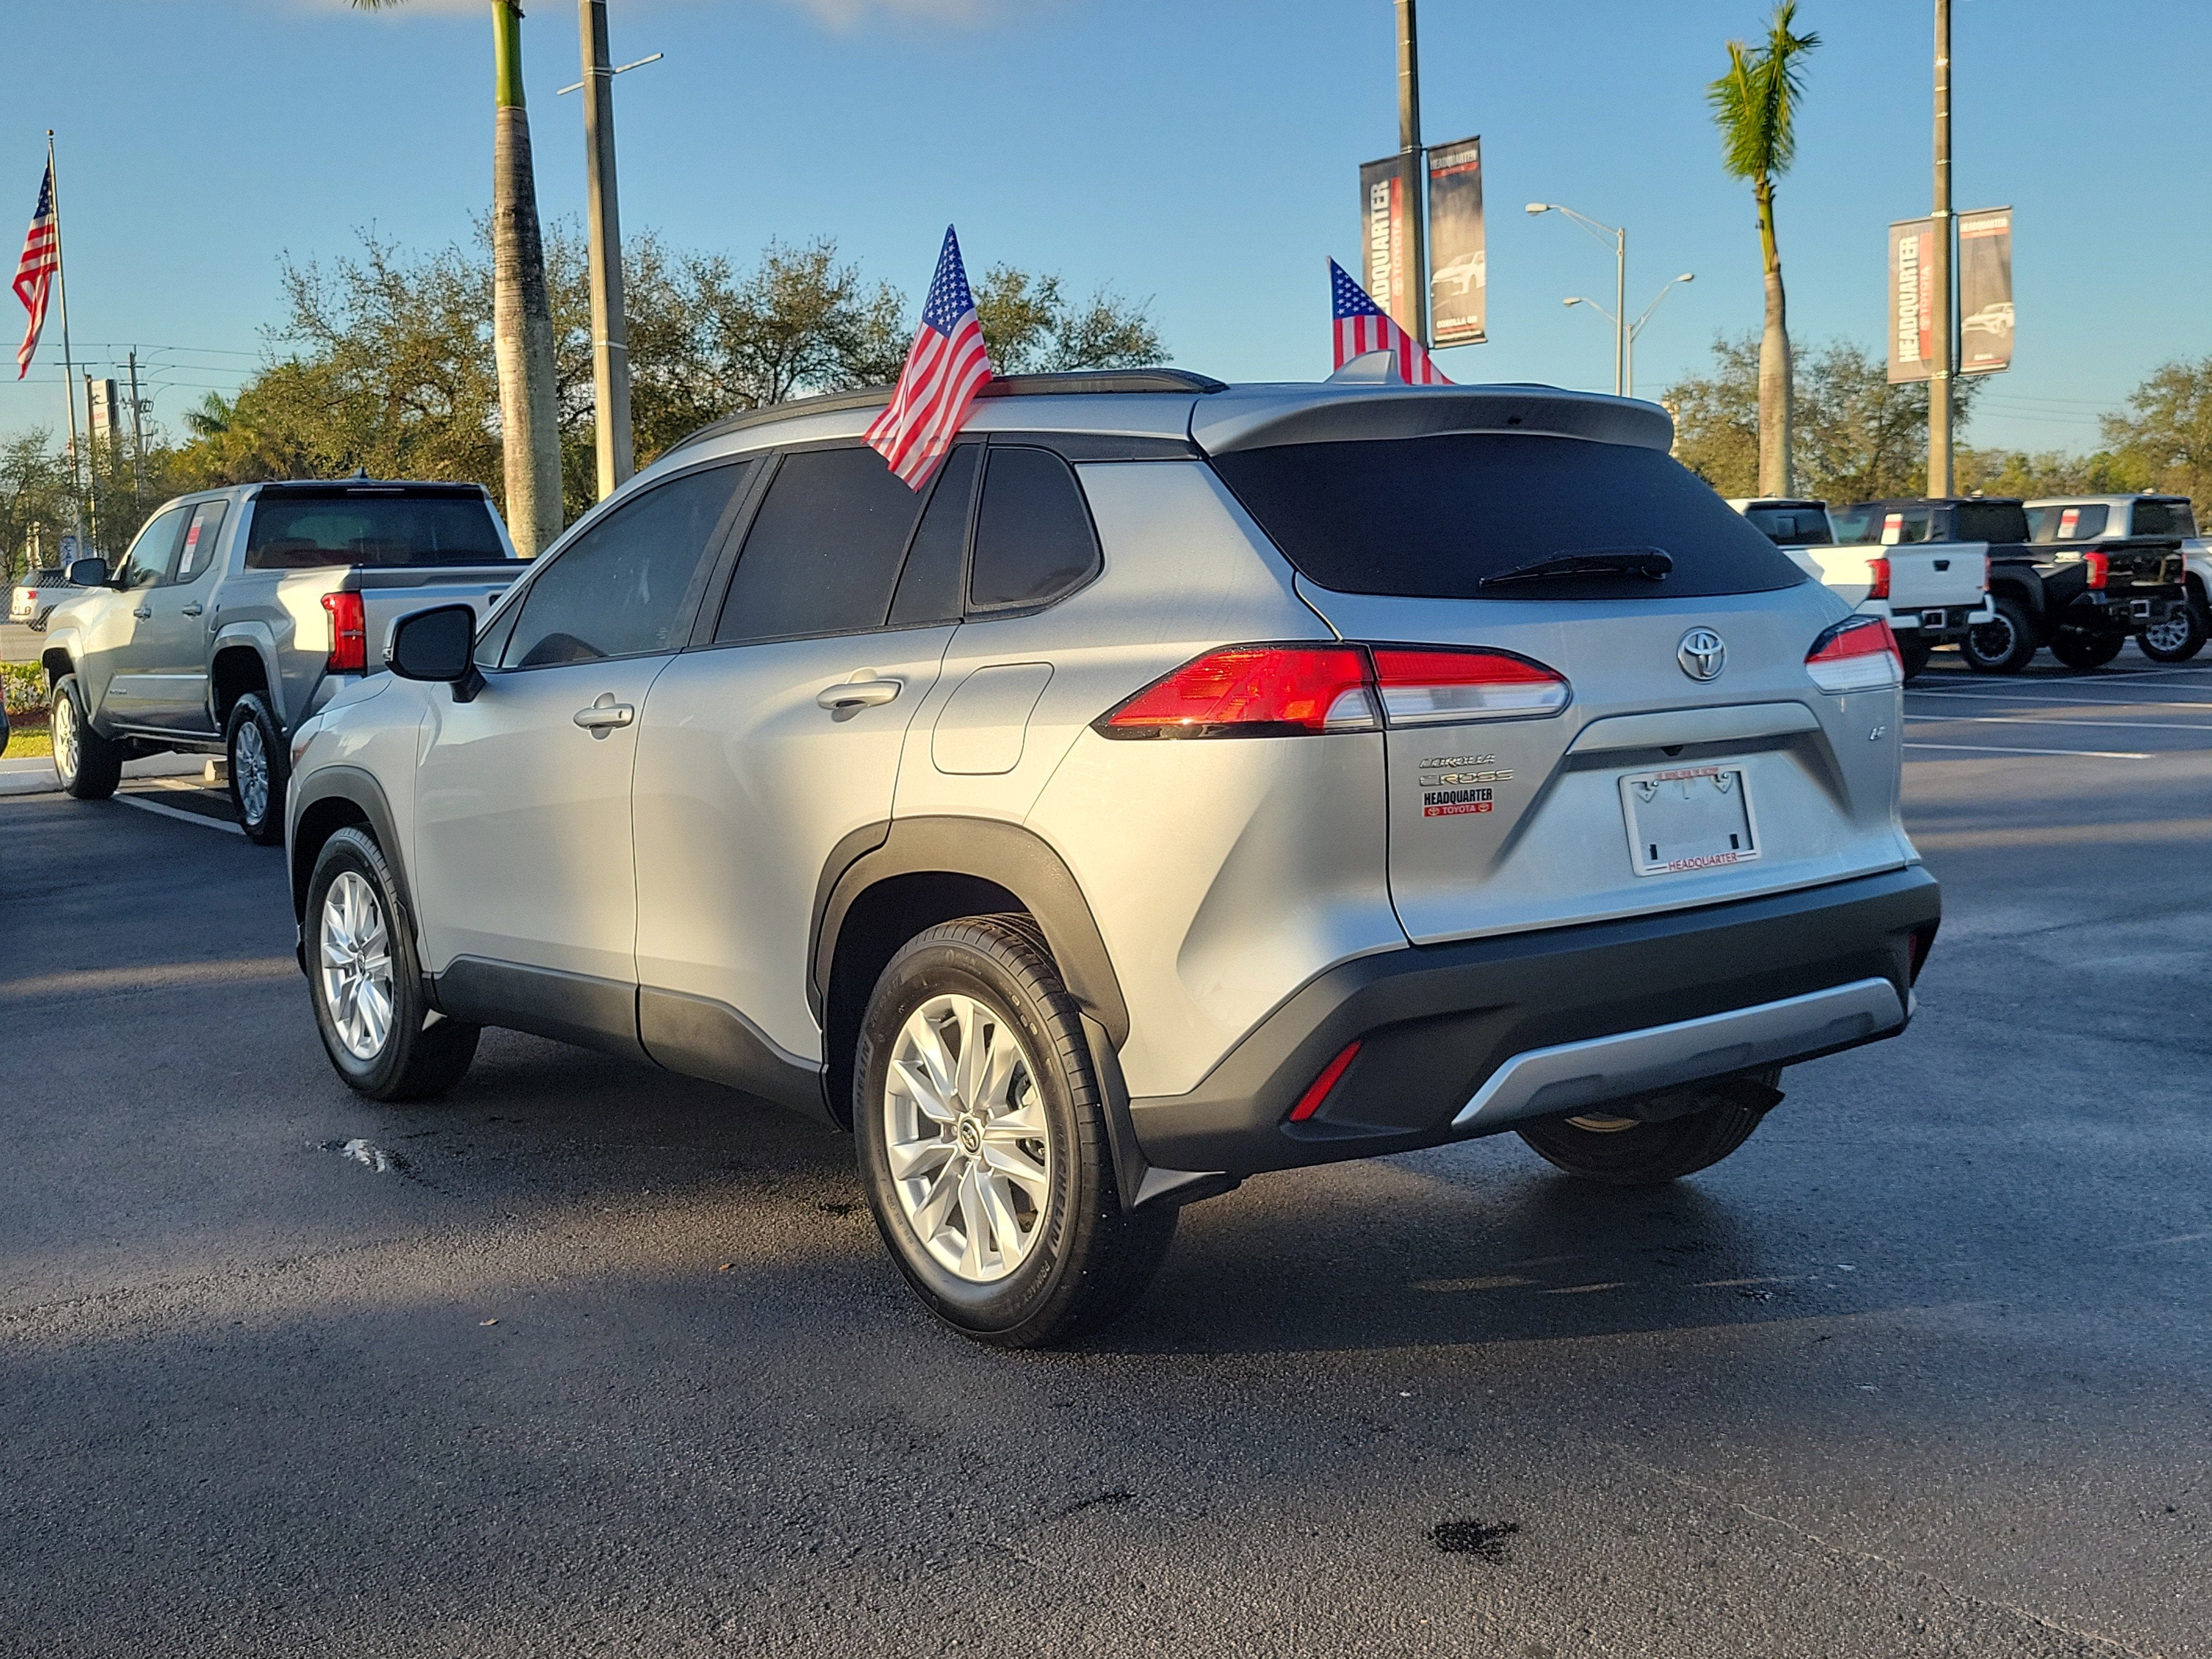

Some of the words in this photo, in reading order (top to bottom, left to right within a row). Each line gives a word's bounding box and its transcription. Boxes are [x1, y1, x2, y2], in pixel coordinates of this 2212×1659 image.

[1370, 180, 1390, 317] ADQUARTER
[1899, 235, 1920, 363] HEADQUARTER
[1419, 769, 1514, 786] CROSS
[1424, 788, 1492, 805] HEADQUARTER
[1442, 805, 1477, 814] TOYOTA
[1668, 853, 1737, 871] HEADQUARTER
[1049, 1121, 1066, 1249] MICHELIN
